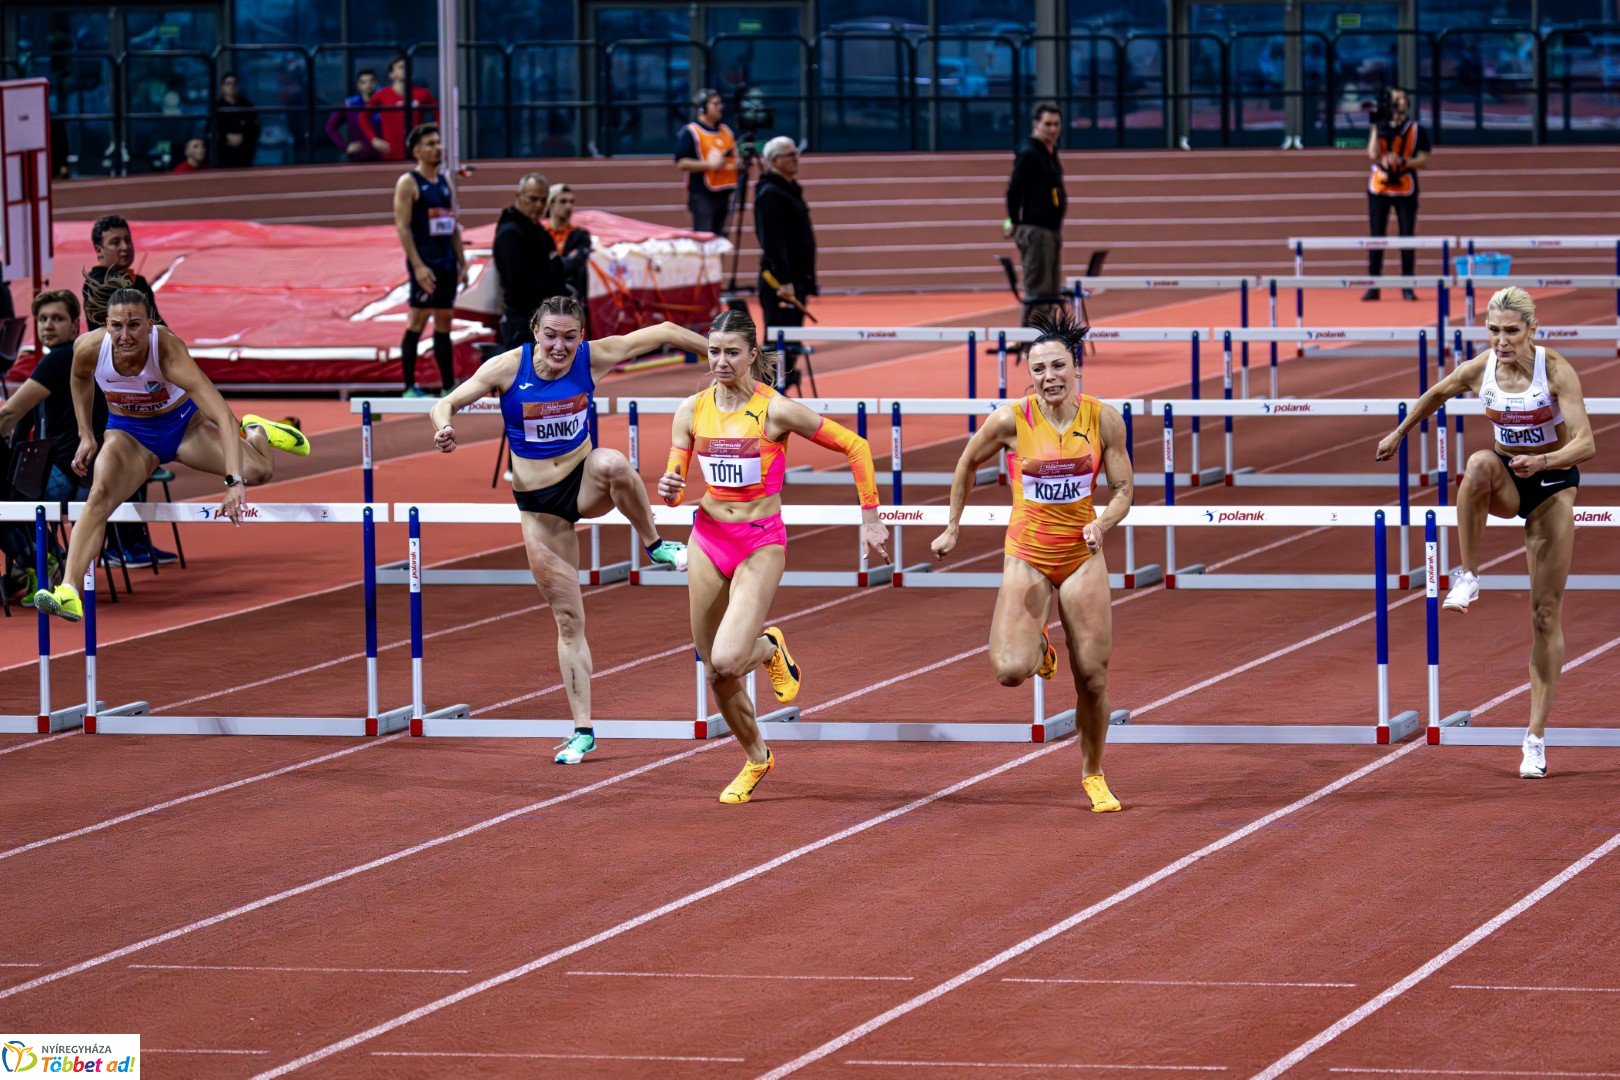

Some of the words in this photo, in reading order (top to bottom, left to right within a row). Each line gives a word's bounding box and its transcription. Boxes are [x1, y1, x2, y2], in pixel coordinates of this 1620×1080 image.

[1273, 403, 1312, 413] polanik
[536, 416, 579, 439] BANKÓ
[709, 460, 743, 483] TÓTH
[1034, 479, 1081, 500] KOZÁK
[1218, 510, 1266, 523] polanik
[1573, 511, 1613, 522] olanik
